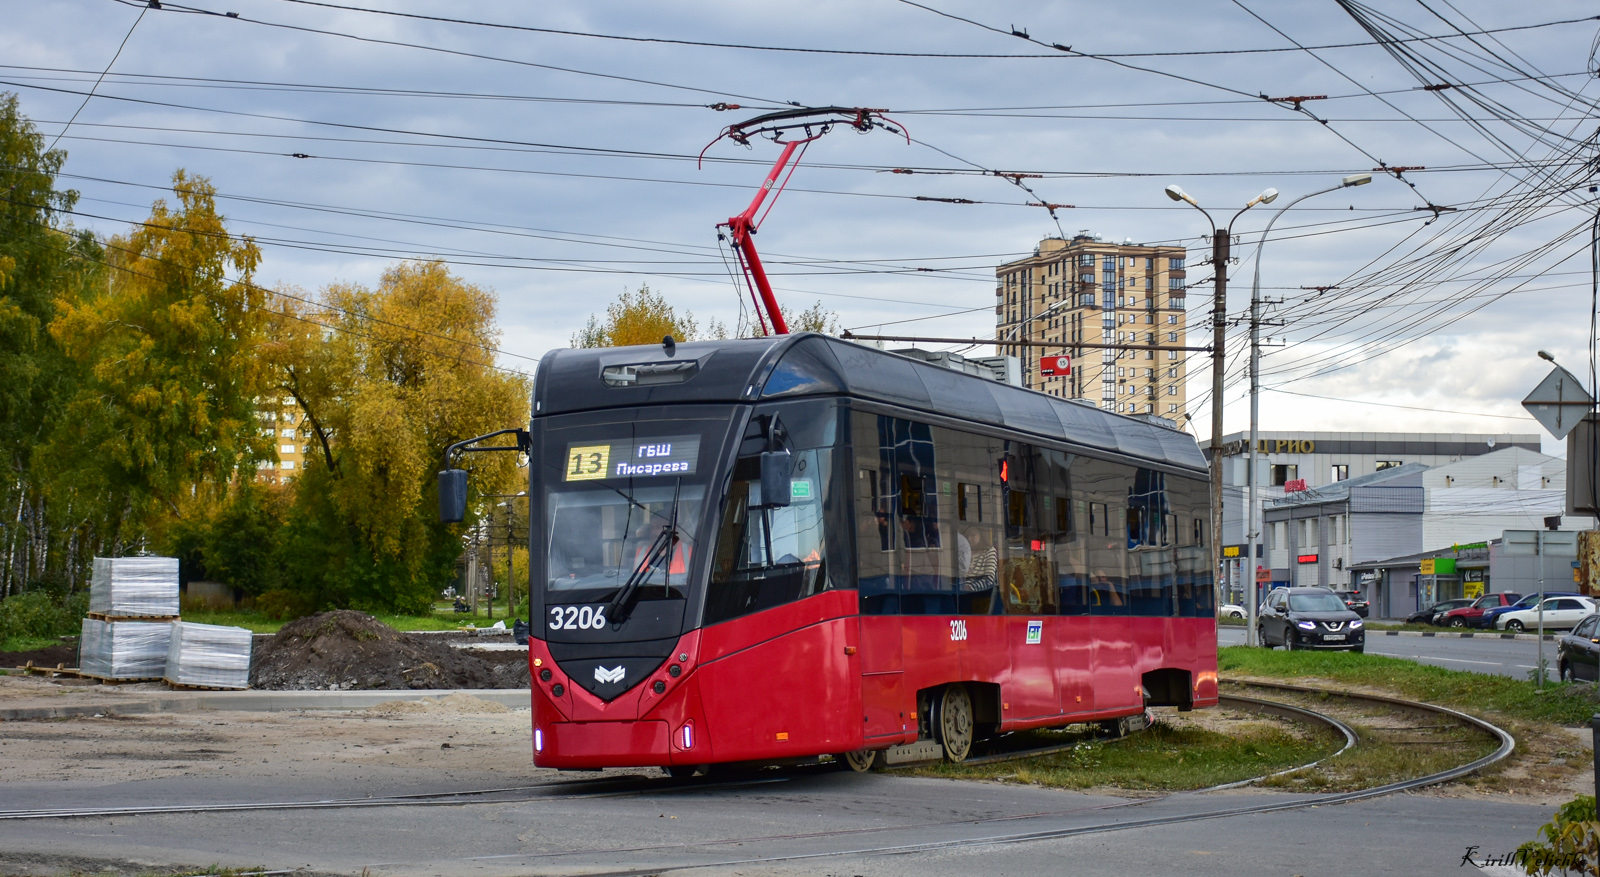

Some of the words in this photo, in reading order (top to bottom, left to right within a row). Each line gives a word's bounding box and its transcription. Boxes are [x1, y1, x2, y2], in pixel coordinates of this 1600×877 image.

[638, 443, 671, 458] ГБШ
[1275, 440, 1315, 456] РИО
[570, 452, 603, 475] 13
[616, 462, 689, 476] Писарева
[549, 606, 606, 630] 3206
[950, 619, 967, 641] 3206
